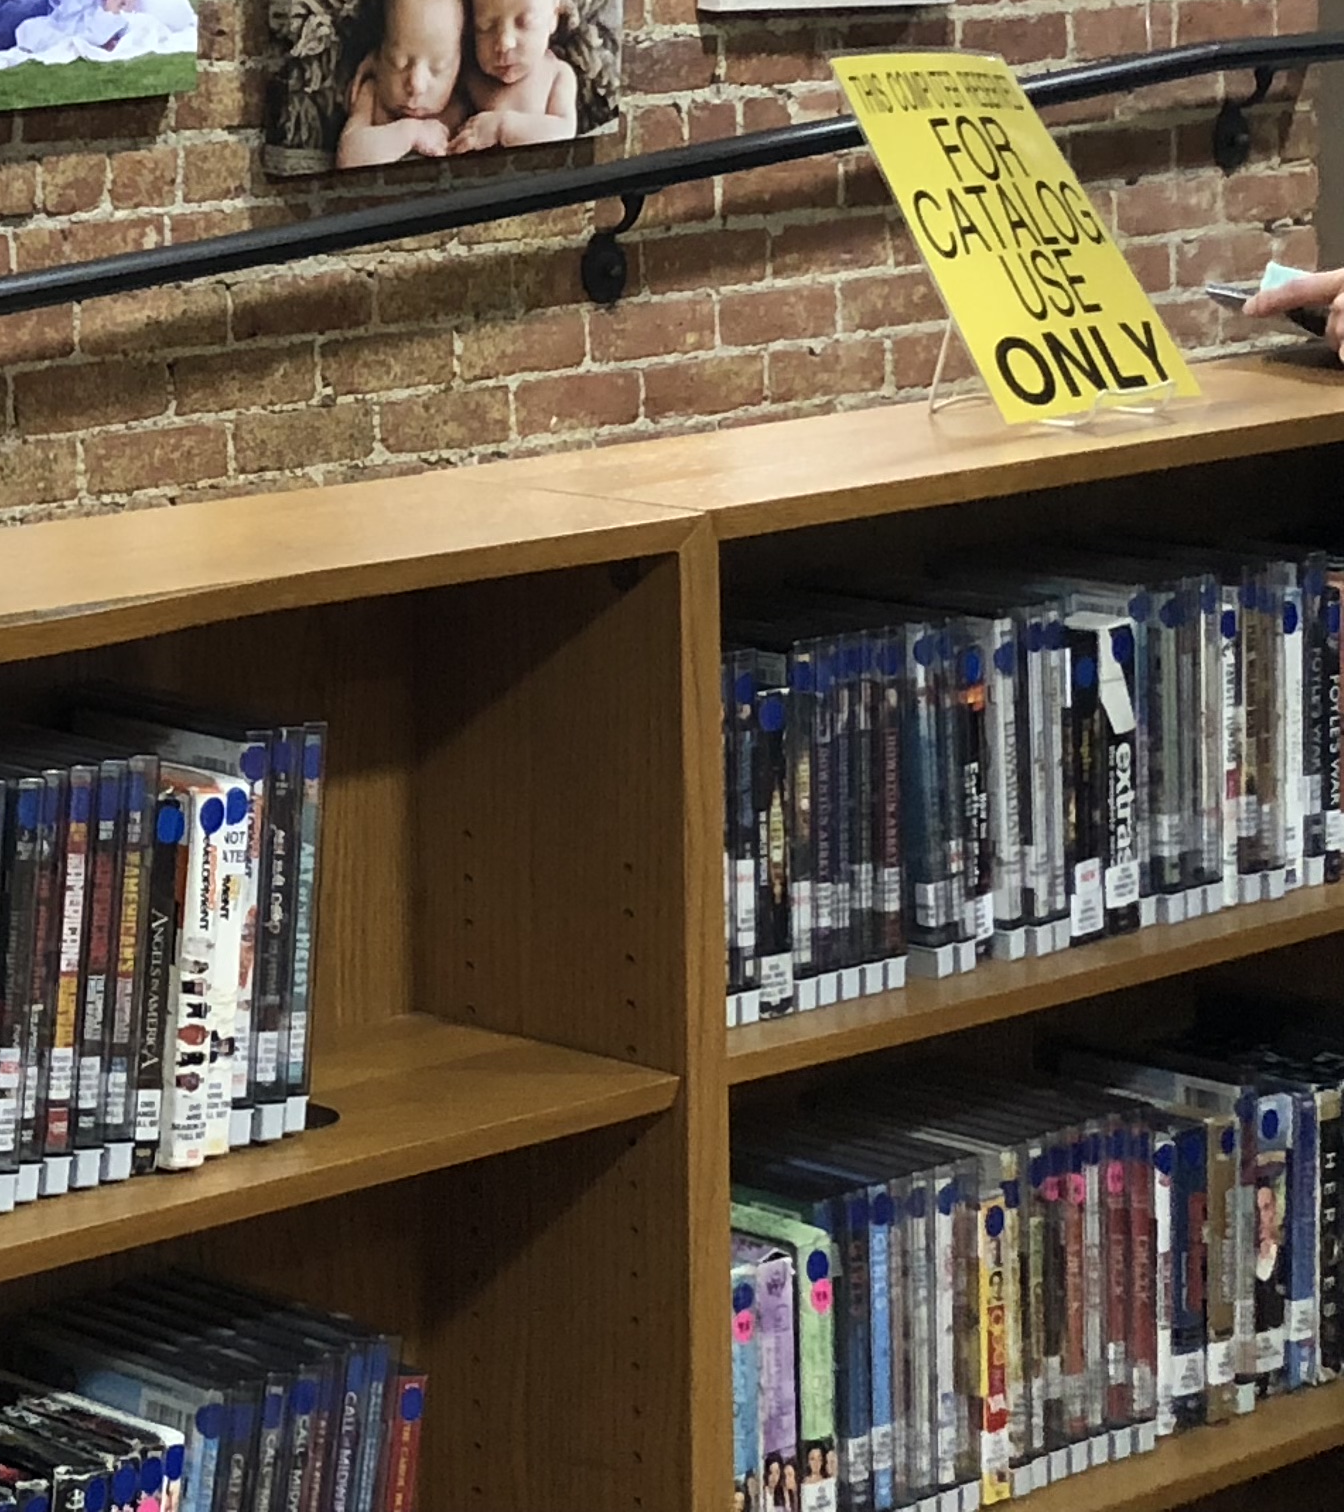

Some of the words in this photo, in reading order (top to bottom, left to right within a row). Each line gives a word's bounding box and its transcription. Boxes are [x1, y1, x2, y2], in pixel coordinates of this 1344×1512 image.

[848, 73, 894, 114] THIS
[929, 116, 1031, 183] FOR
[912, 180, 1106, 262] CATALOG
[998, 248, 1103, 322] USE
[994, 320, 1170, 407] ONLY
[1327, 674, 1341, 756] FOYLE'S
[1115, 742, 1134, 866] extras
[1328, 760, 1341, 806] WAR
[150, 908, 170, 979] ANGELS
[141, 992, 160, 1069] AMERICA
[295, 1415, 310, 1455] CALL
[342, 1391, 358, 1434] CALL
